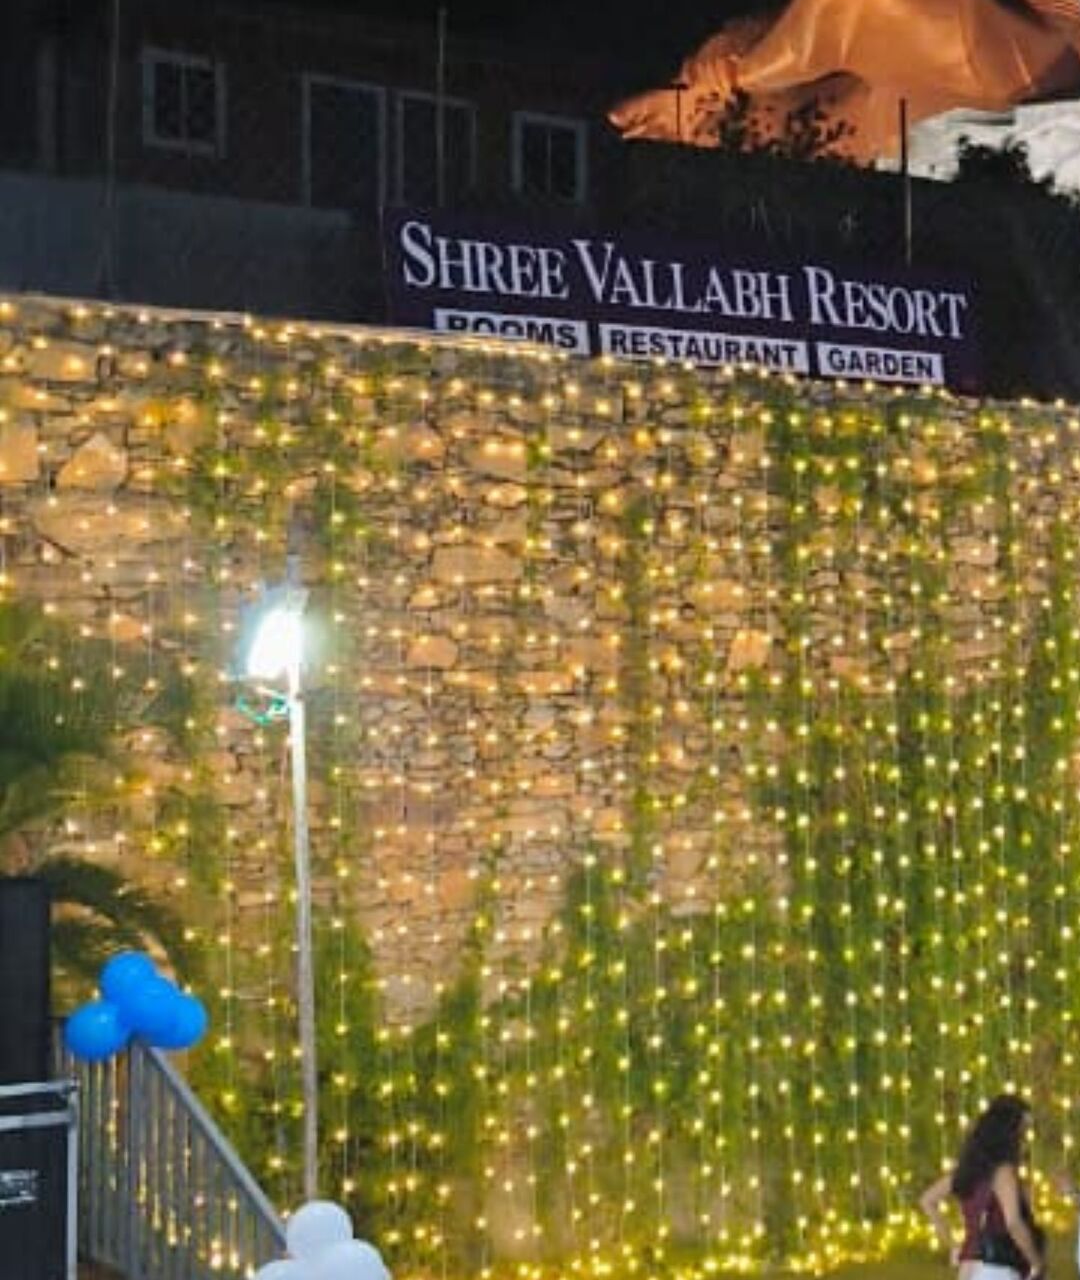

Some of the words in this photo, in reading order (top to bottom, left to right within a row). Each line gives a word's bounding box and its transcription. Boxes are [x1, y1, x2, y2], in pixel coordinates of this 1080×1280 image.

[401, 221, 569, 299] SHREE
[571, 239, 792, 321] VALLABH
[803, 266, 968, 339] RESORT
[610, 329, 798, 367] RESTAURANT
[828, 347, 934, 378] GARDEN
